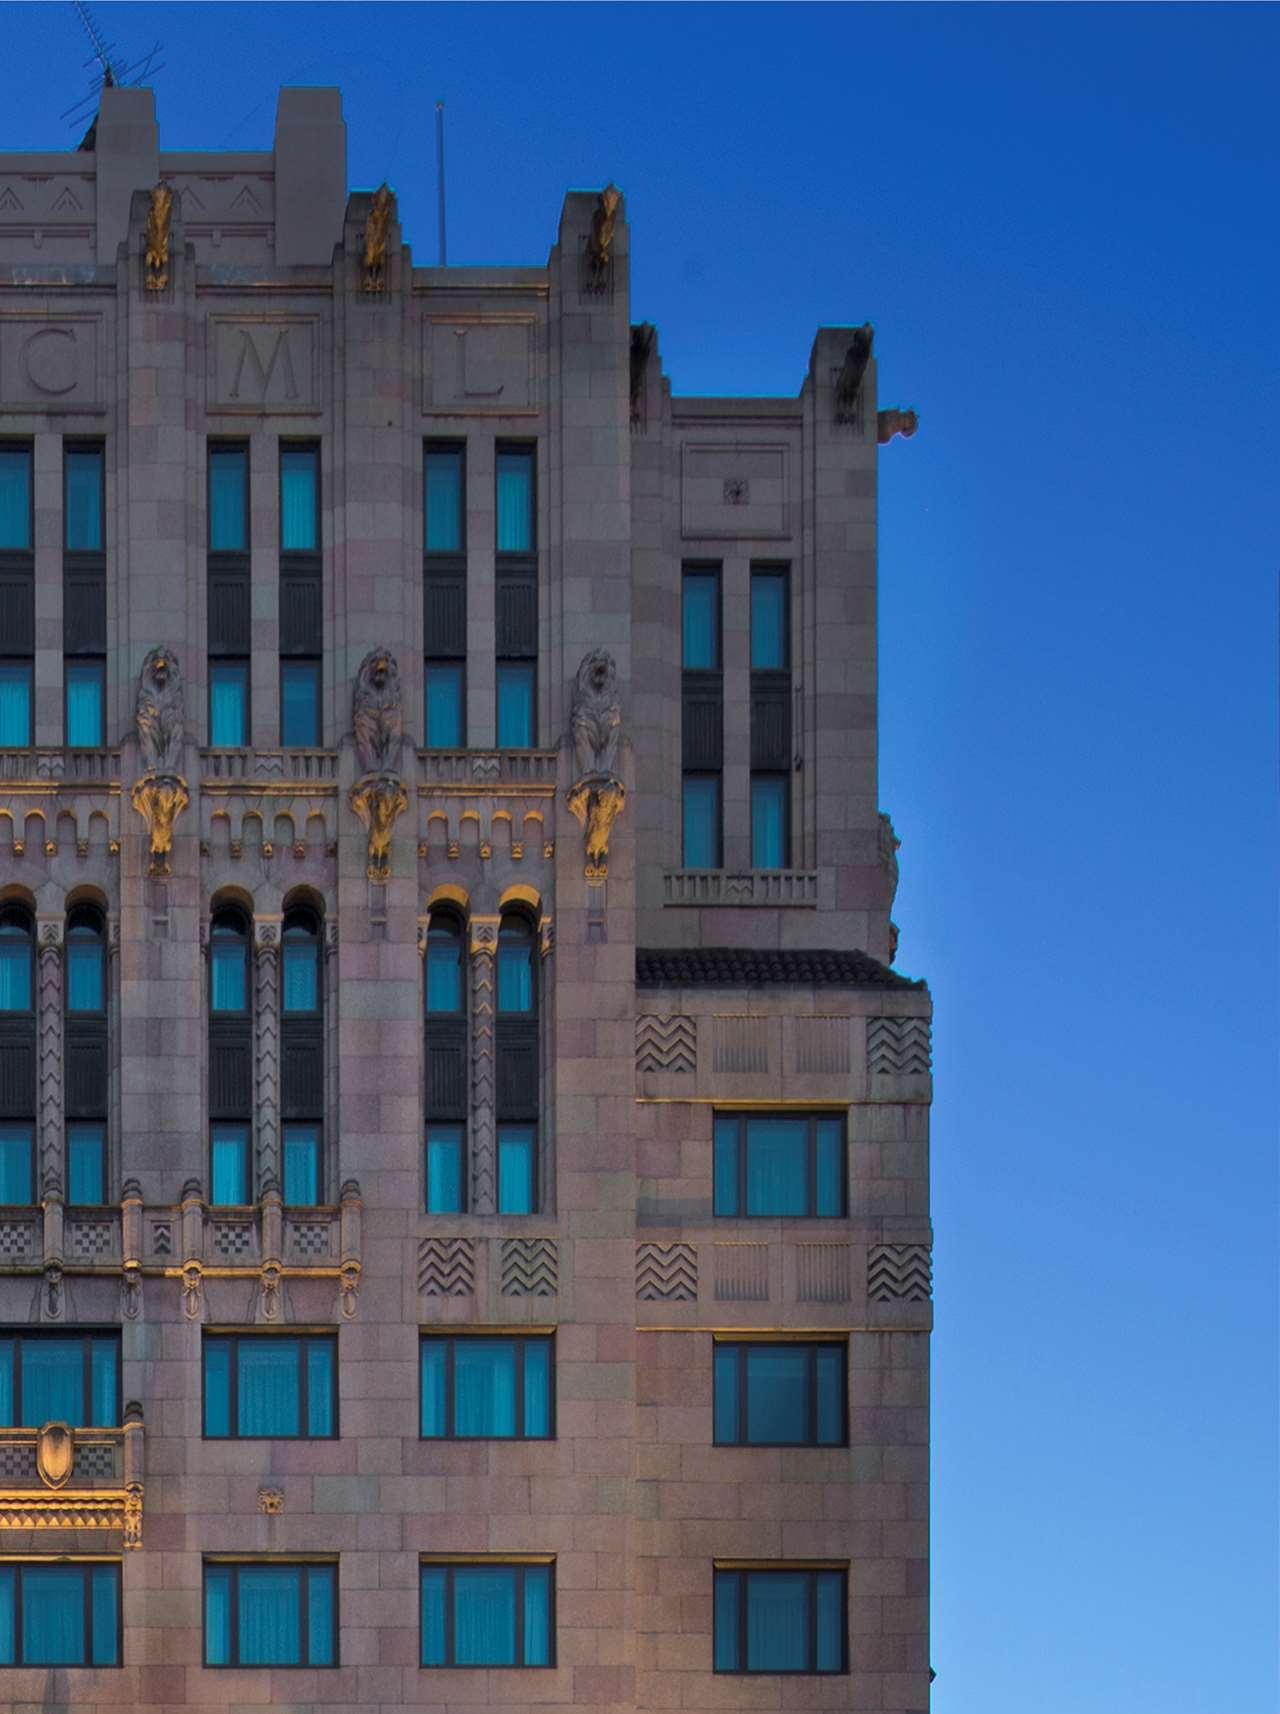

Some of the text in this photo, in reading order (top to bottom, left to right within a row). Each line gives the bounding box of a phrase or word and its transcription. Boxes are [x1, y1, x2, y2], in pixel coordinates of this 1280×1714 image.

[21, 328, 77, 395] C
[229, 330, 299, 398] M
[453, 329, 504, 398] L
